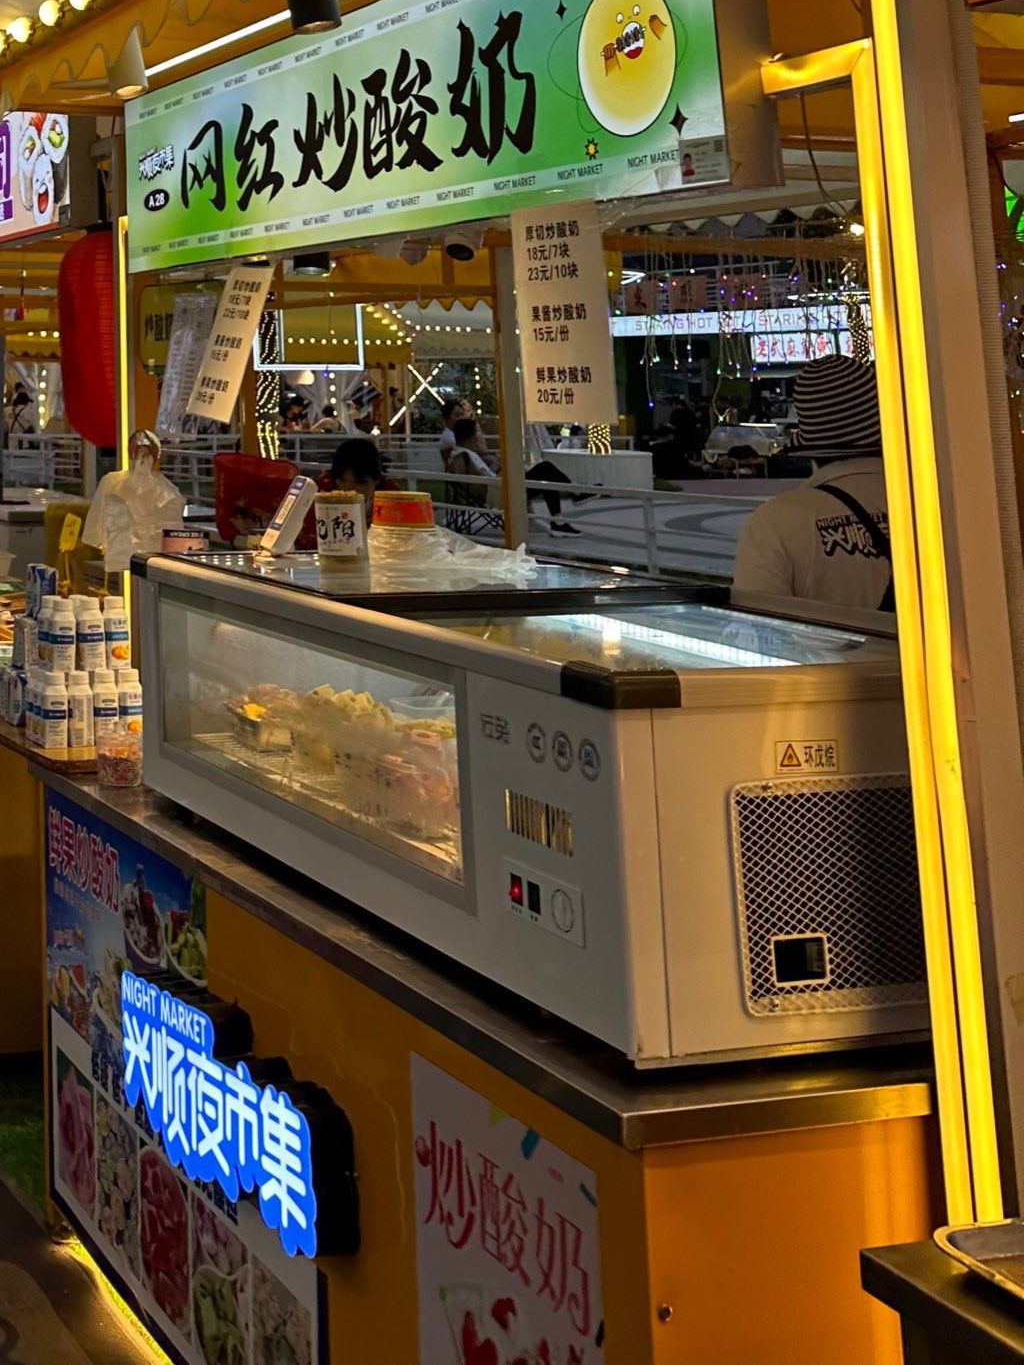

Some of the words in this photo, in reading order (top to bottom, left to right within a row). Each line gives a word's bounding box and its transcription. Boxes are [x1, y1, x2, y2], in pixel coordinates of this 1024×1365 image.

[377, 19, 390, 30] NIGHT
[390, 12, 409, 26] MARKET
[426, 0, 440, 13] NIGHT
[181, 11, 536, 211] 网红炒酸奶
[386, 200, 400, 209] NIGHT
[401, 196, 420, 207] MARKET
[437, 191, 451, 201] NIGHT
[453, 187, 474, 198] MARKET
[494, 180, 511, 190] NIGHT
[513, 176, 536, 188] MARKET
[557, 169, 576, 181] NIGHT
[578, 164, 603, 177] MARKET
[627, 155, 648, 168] NIGHT
[650, 149, 679, 164] MARKET
[525, 220, 579, 241] 厚切炒酸奶
[527, 244, 570, 261] 18元/7块
[528, 262, 578, 281] 23元/10块
[532, 303, 586, 322] 果酱炒酸奶
[533, 325, 569, 342] 15元/份
[536, 366, 591, 384] 鲜果炒酸奶
[538, 388, 574, 405] 20元/份
[817, 516, 847, 527] NIGHT
[804, 743, 835, 767] 环戊烷
[123, 979, 157, 1017] NIGHT
[160, 992, 206, 1046] MARKET
[415, 1121, 590, 1336] 炒酸奶
